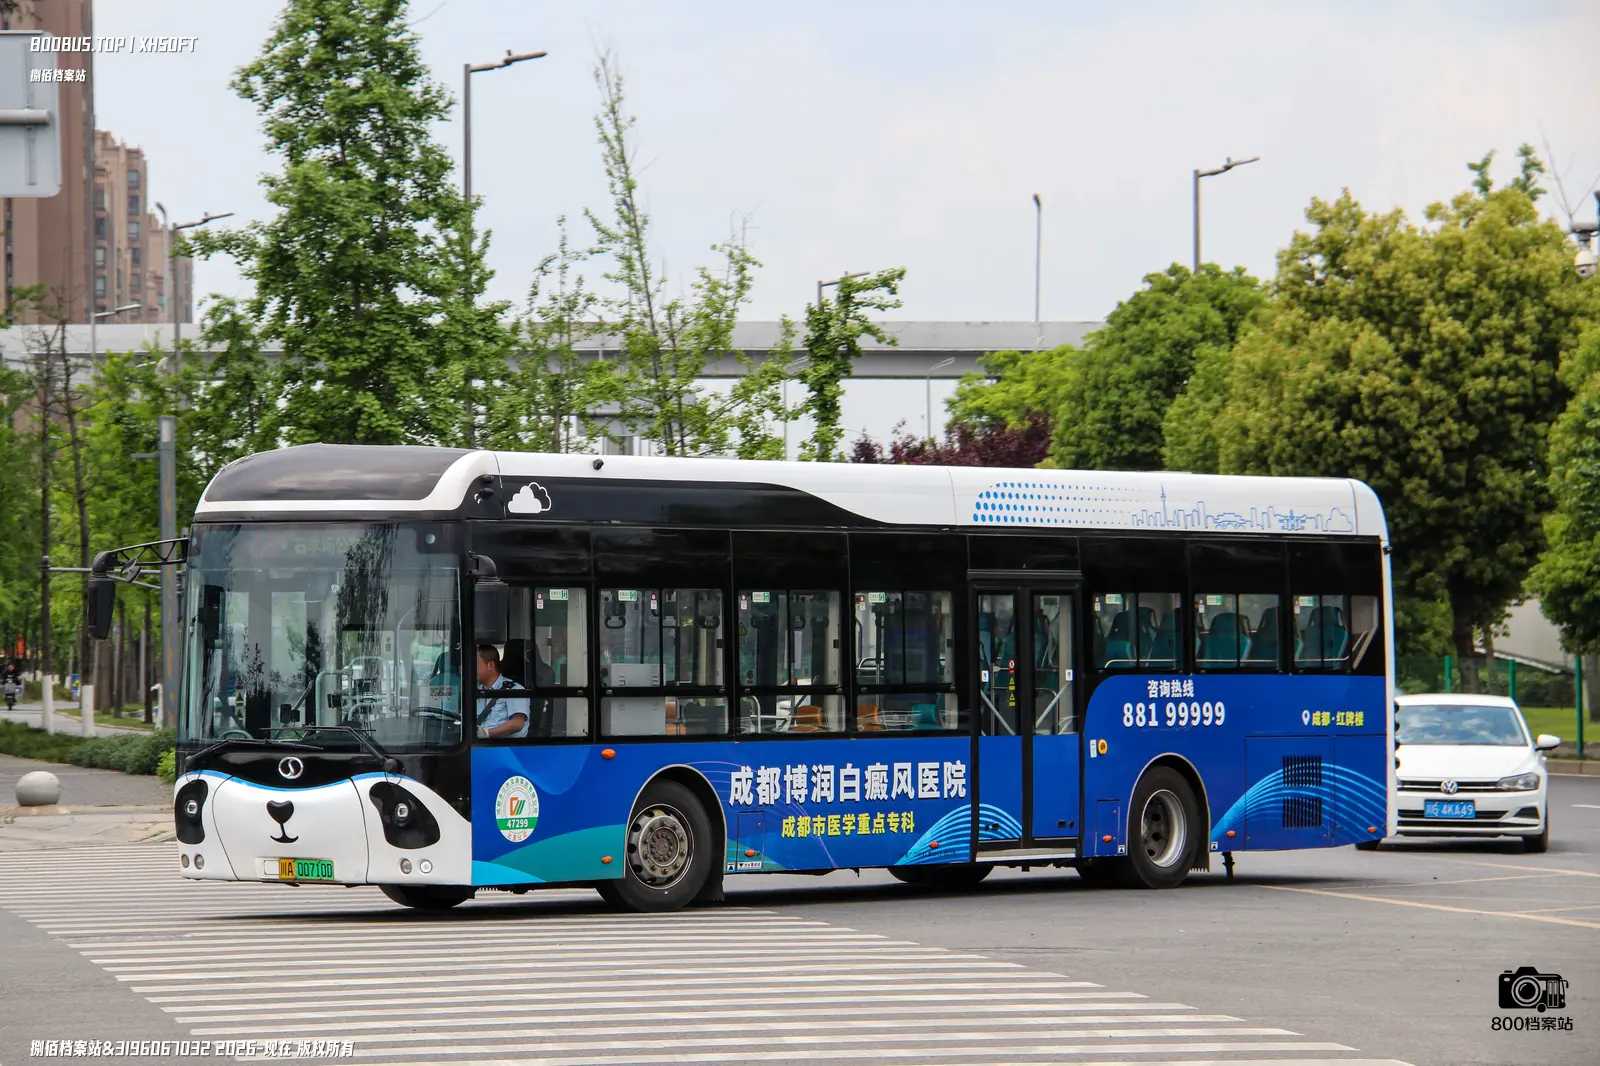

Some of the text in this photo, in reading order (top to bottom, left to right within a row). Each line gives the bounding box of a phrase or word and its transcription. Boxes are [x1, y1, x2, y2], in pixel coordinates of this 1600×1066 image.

[1147, 679, 1195, 698] 咨询热线
[1122, 701, 1226, 727] 881 99999
[728, 760, 967, 806] 成都博润白癜风医院
[506, 819, 529, 829] 47299
[781, 811, 916, 838] 成都市医学重点专科
